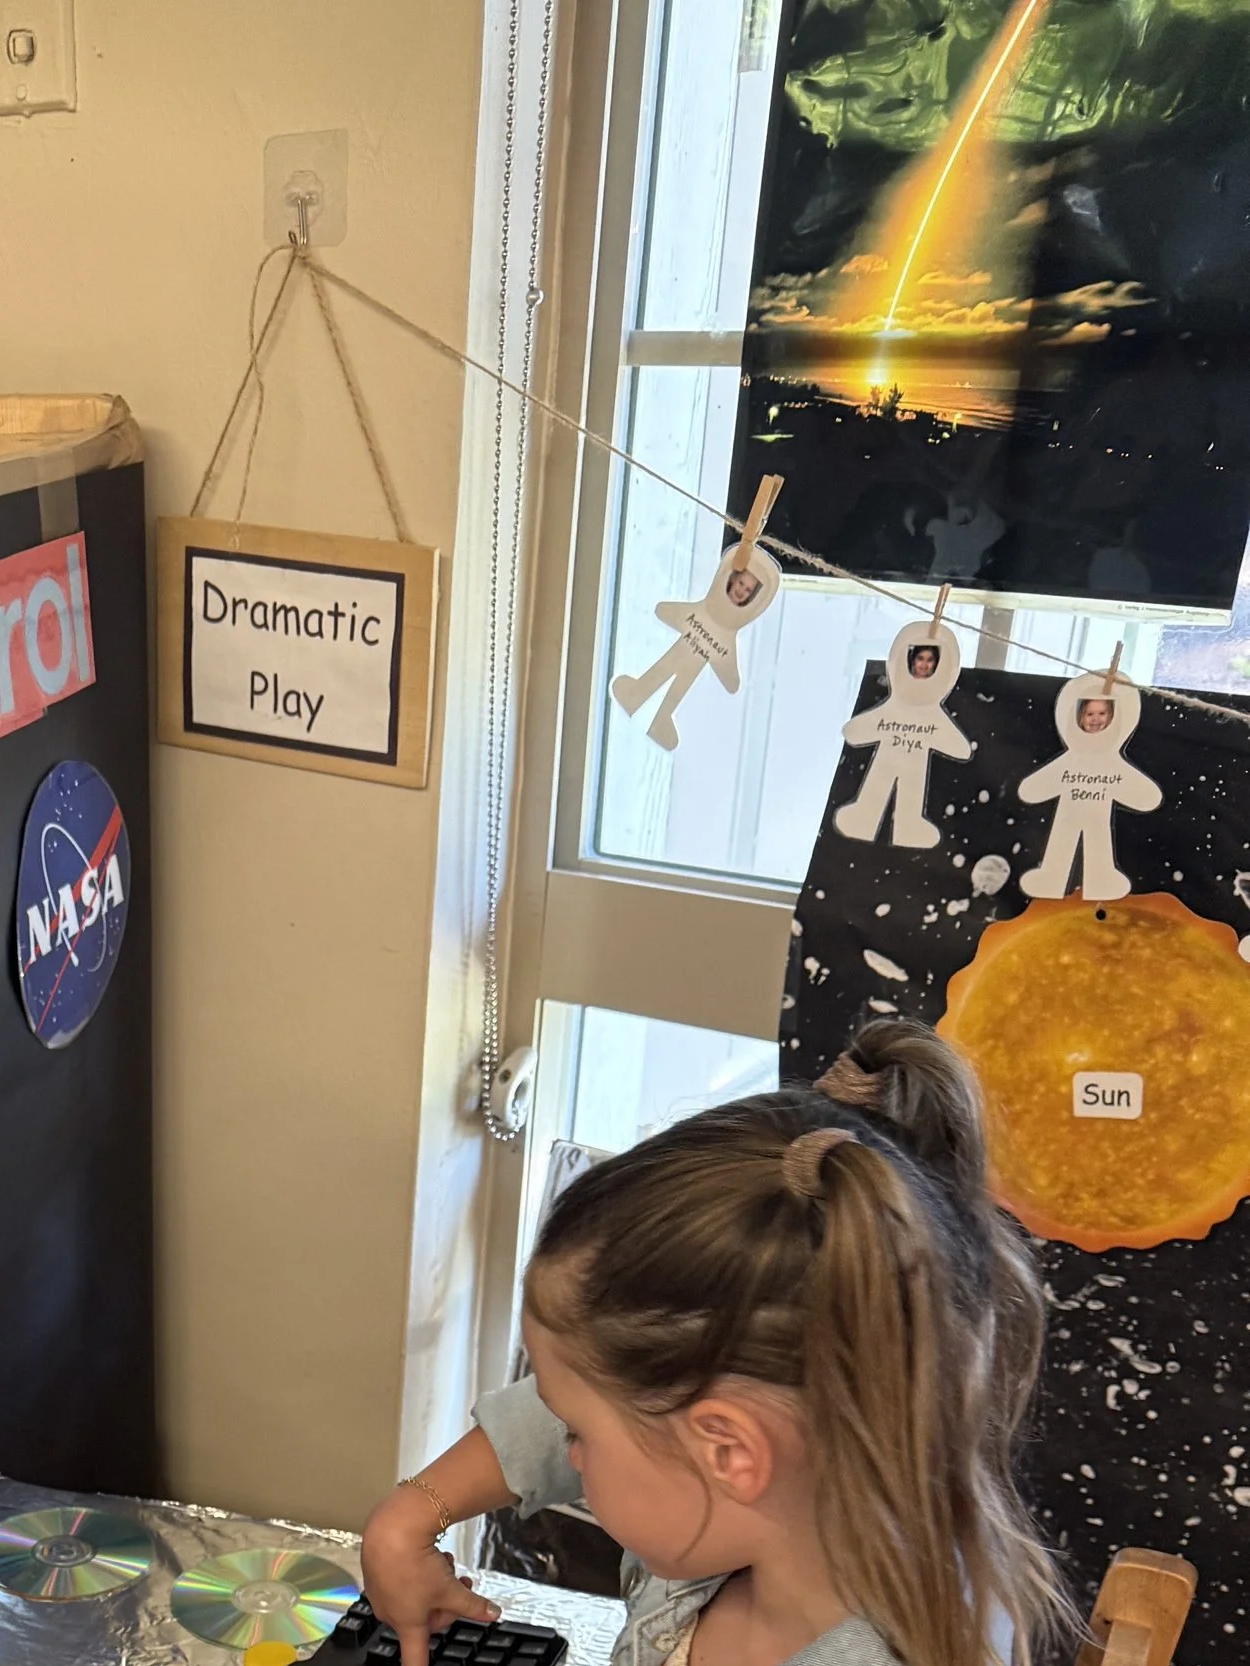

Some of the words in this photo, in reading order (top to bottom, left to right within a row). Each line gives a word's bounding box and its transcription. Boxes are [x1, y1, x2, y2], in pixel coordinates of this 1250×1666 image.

[203, 580, 381, 646] Dramatic
[683, 631, 710, 662] Aliyah
[686, 612, 729, 658] Astronaut
[250, 670, 324, 733] Play
[877, 718, 938, 735] Astronaut
[892, 733, 923, 753] Diya
[1061, 769, 1123, 785] Astronaut
[1071, 788, 1107, 801] Benni
[27, 854, 125, 963] NASA
[1082, 1083, 1131, 1107] Sun
